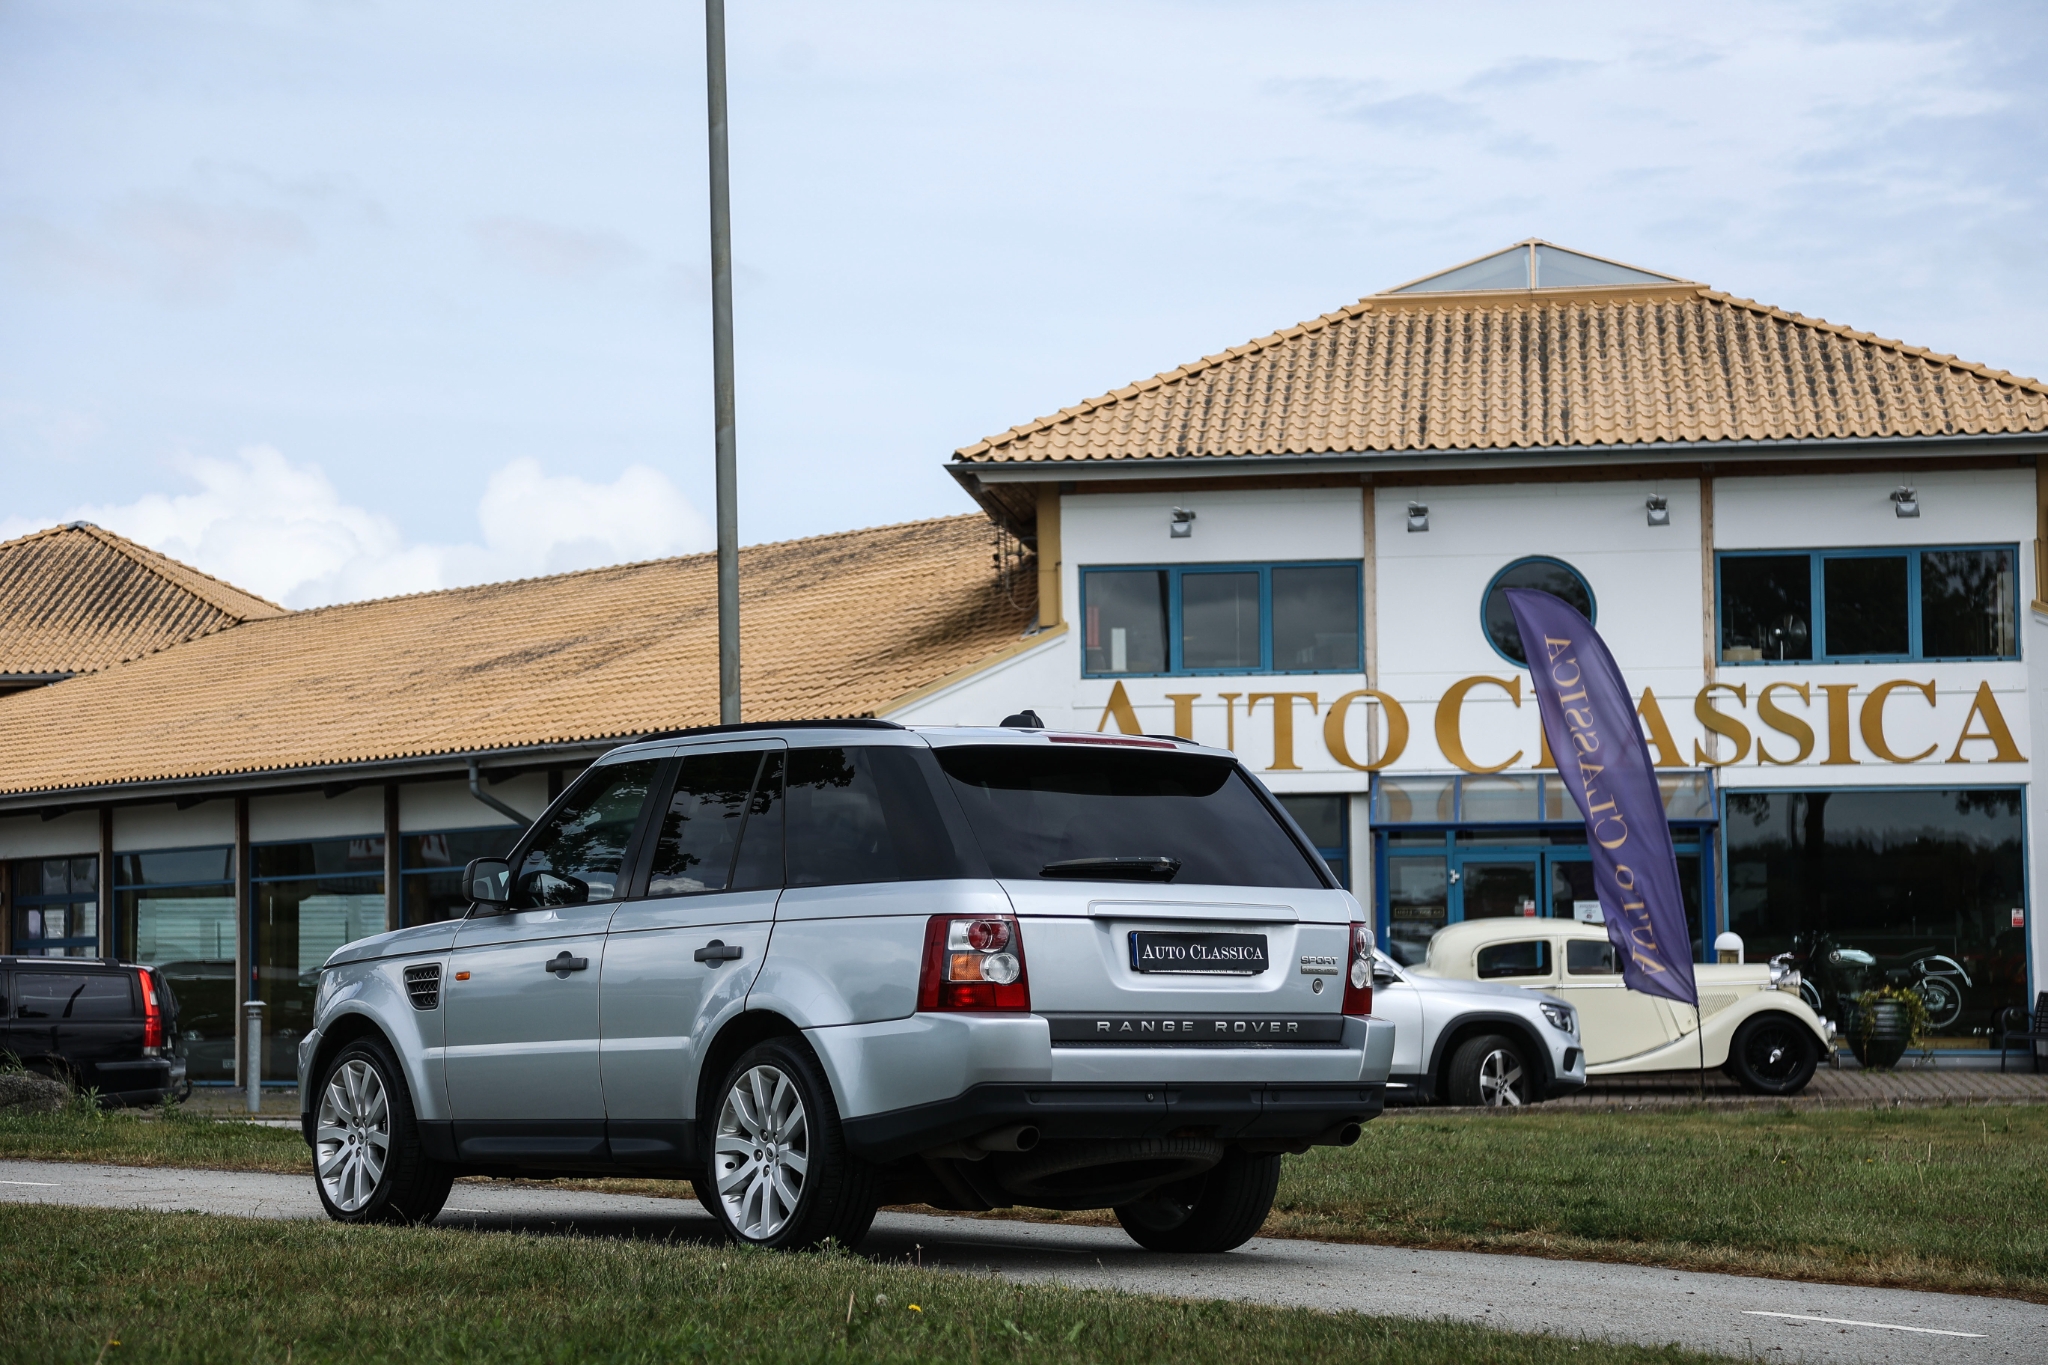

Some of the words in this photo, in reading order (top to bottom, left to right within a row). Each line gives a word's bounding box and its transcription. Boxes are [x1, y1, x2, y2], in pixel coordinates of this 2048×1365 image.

[1434, 675, 2029, 774] CASSICA
[1142, 944, 1186, 959] AUTO
[1189, 944, 1264, 959] CLASSICA
[1300, 955, 1339, 965] SPORT
[1096, 1021, 1194, 1032] RANGE
[1214, 1021, 1299, 1033] ROVER
